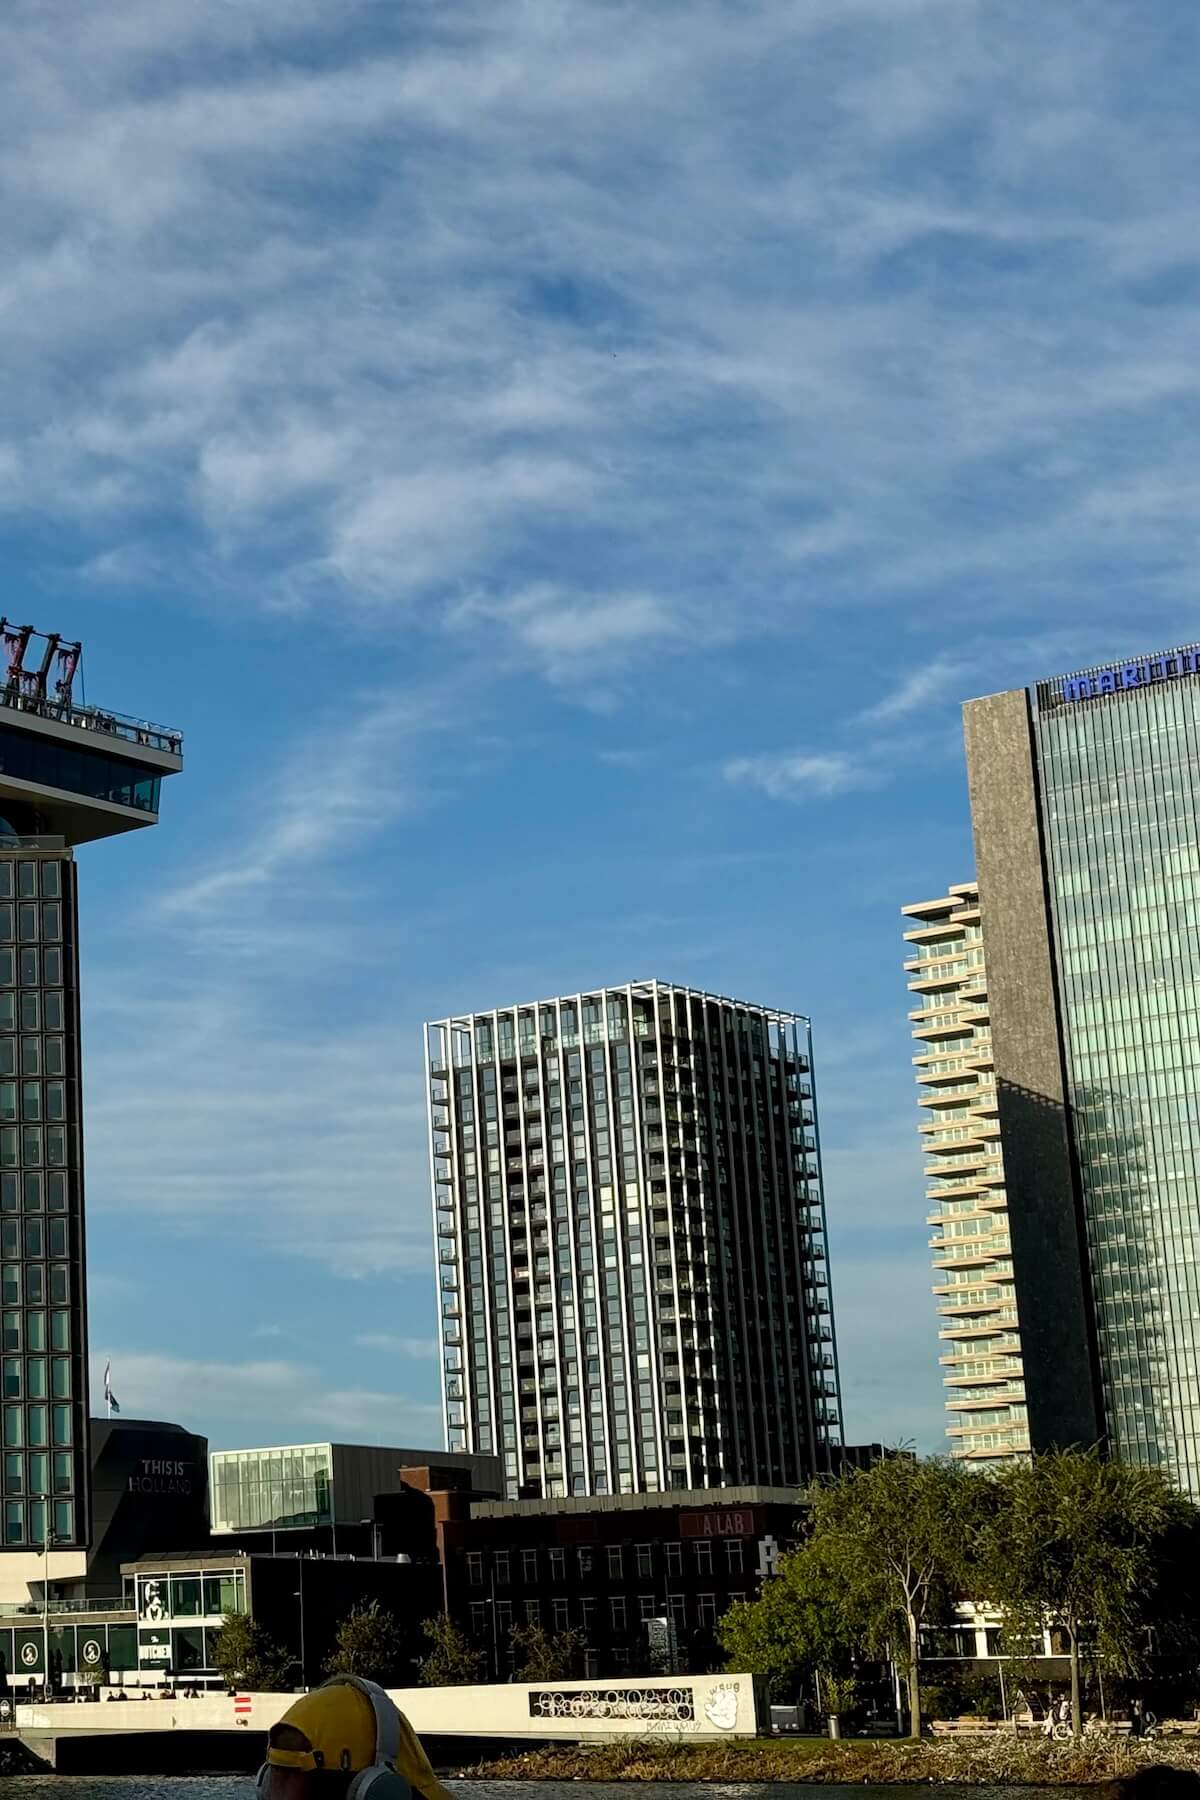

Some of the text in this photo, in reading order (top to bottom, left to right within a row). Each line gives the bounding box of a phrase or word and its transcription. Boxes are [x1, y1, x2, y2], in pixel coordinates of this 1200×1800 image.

[142, 1459, 185, 1477] THIS IS
[128, 1476, 192, 1495] HOLLAND
[703, 1513, 745, 1536] A LAB
